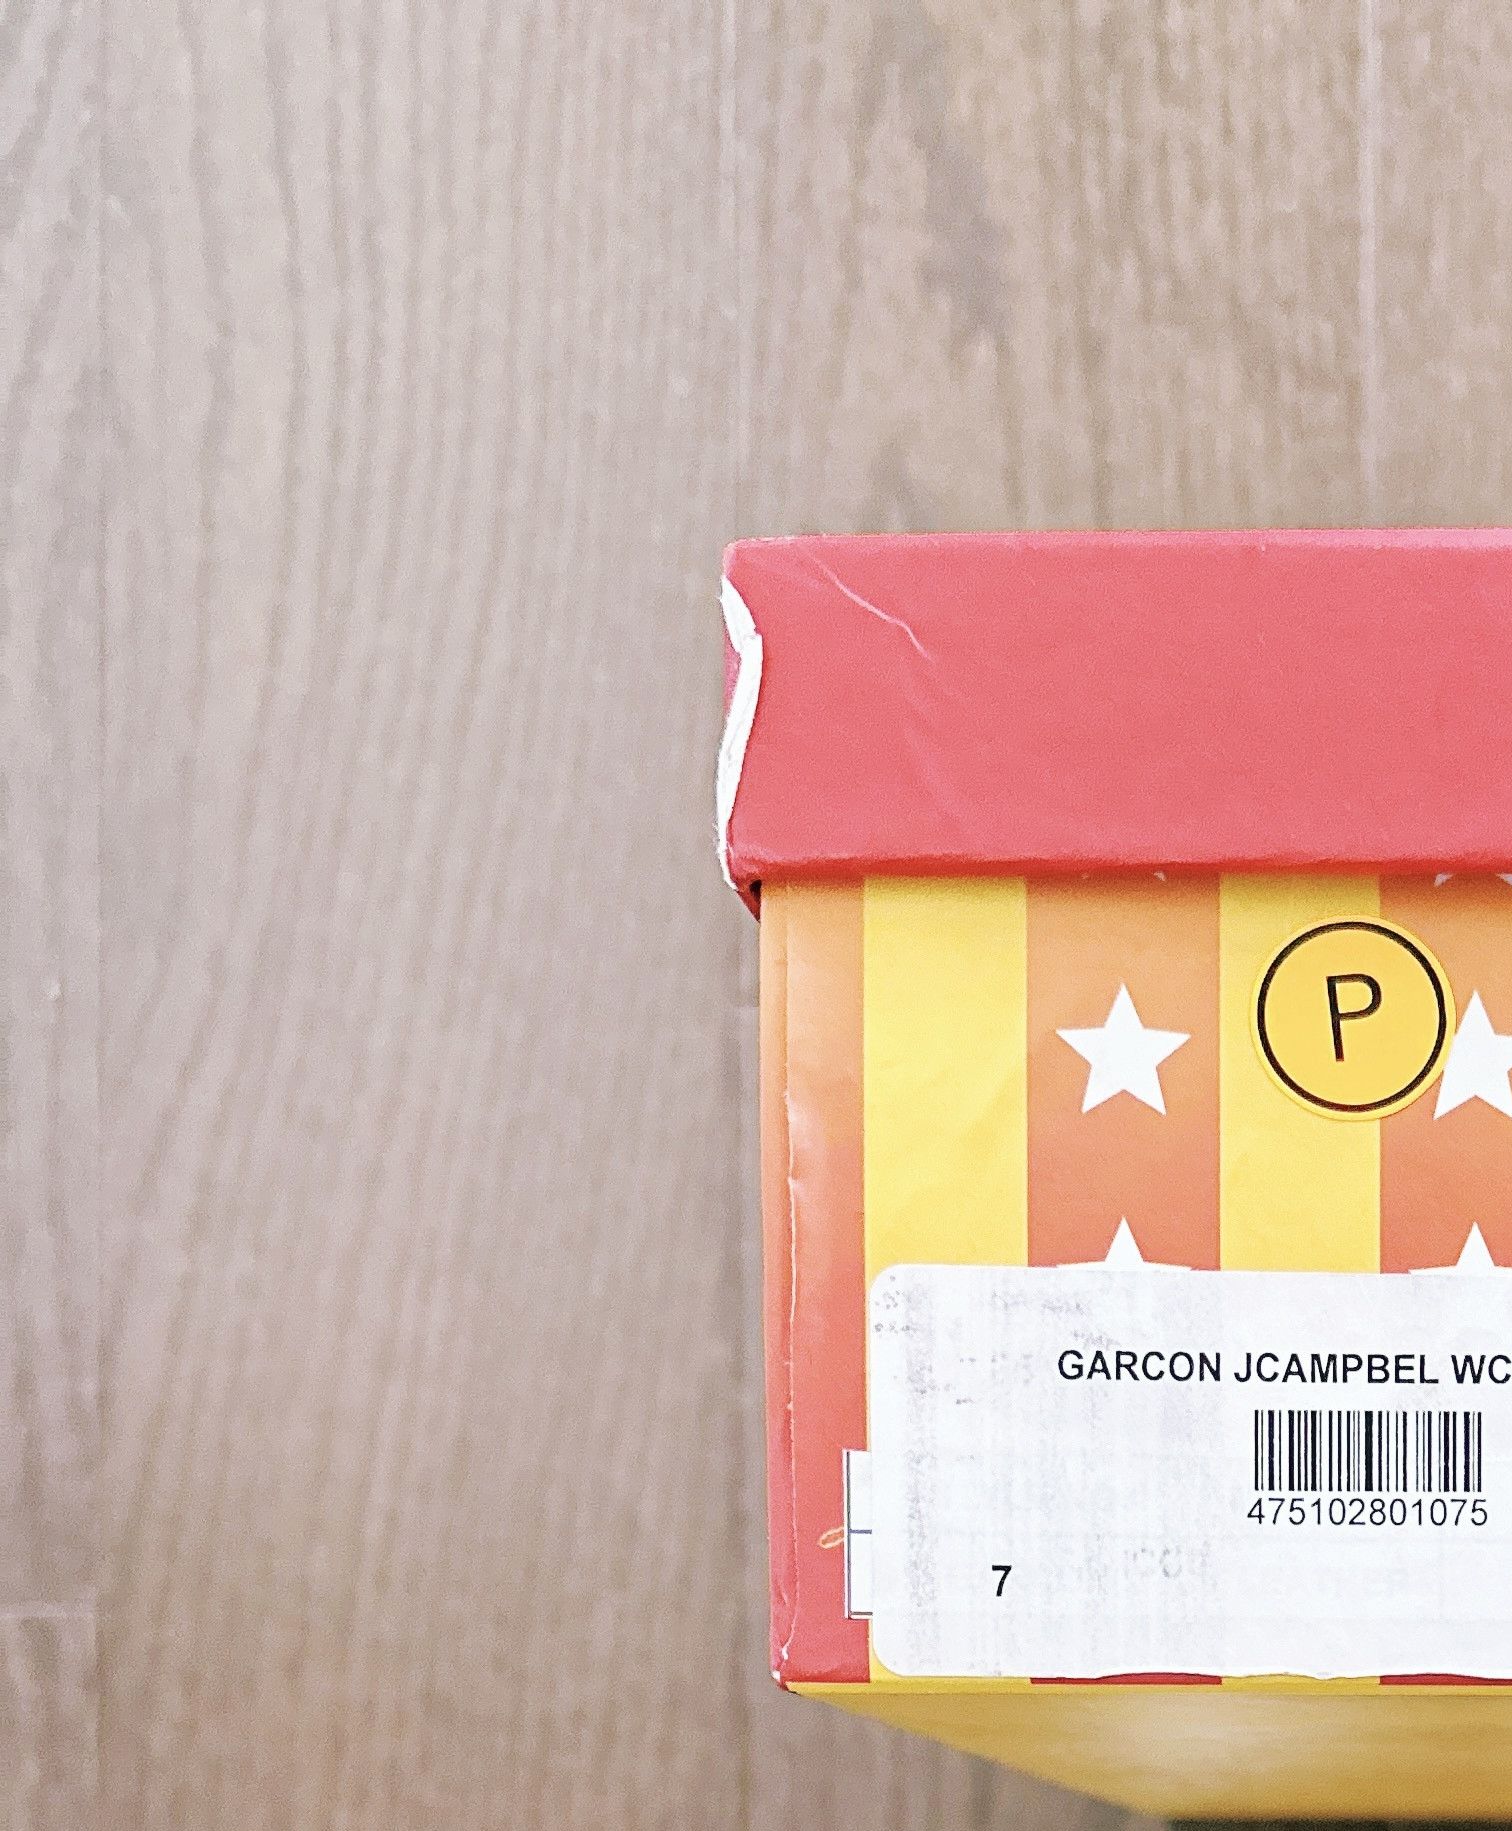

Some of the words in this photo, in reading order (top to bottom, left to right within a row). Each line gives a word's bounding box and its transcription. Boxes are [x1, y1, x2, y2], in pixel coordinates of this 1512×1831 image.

[1325, 973, 1382, 1062] P
[1056, 1348, 1221, 1383] GARCON
[1233, 1352, 1439, 1384] JCAMPBEL
[1246, 1497, 1488, 1527] 475102801075
[991, 1564, 1012, 1597] 7
